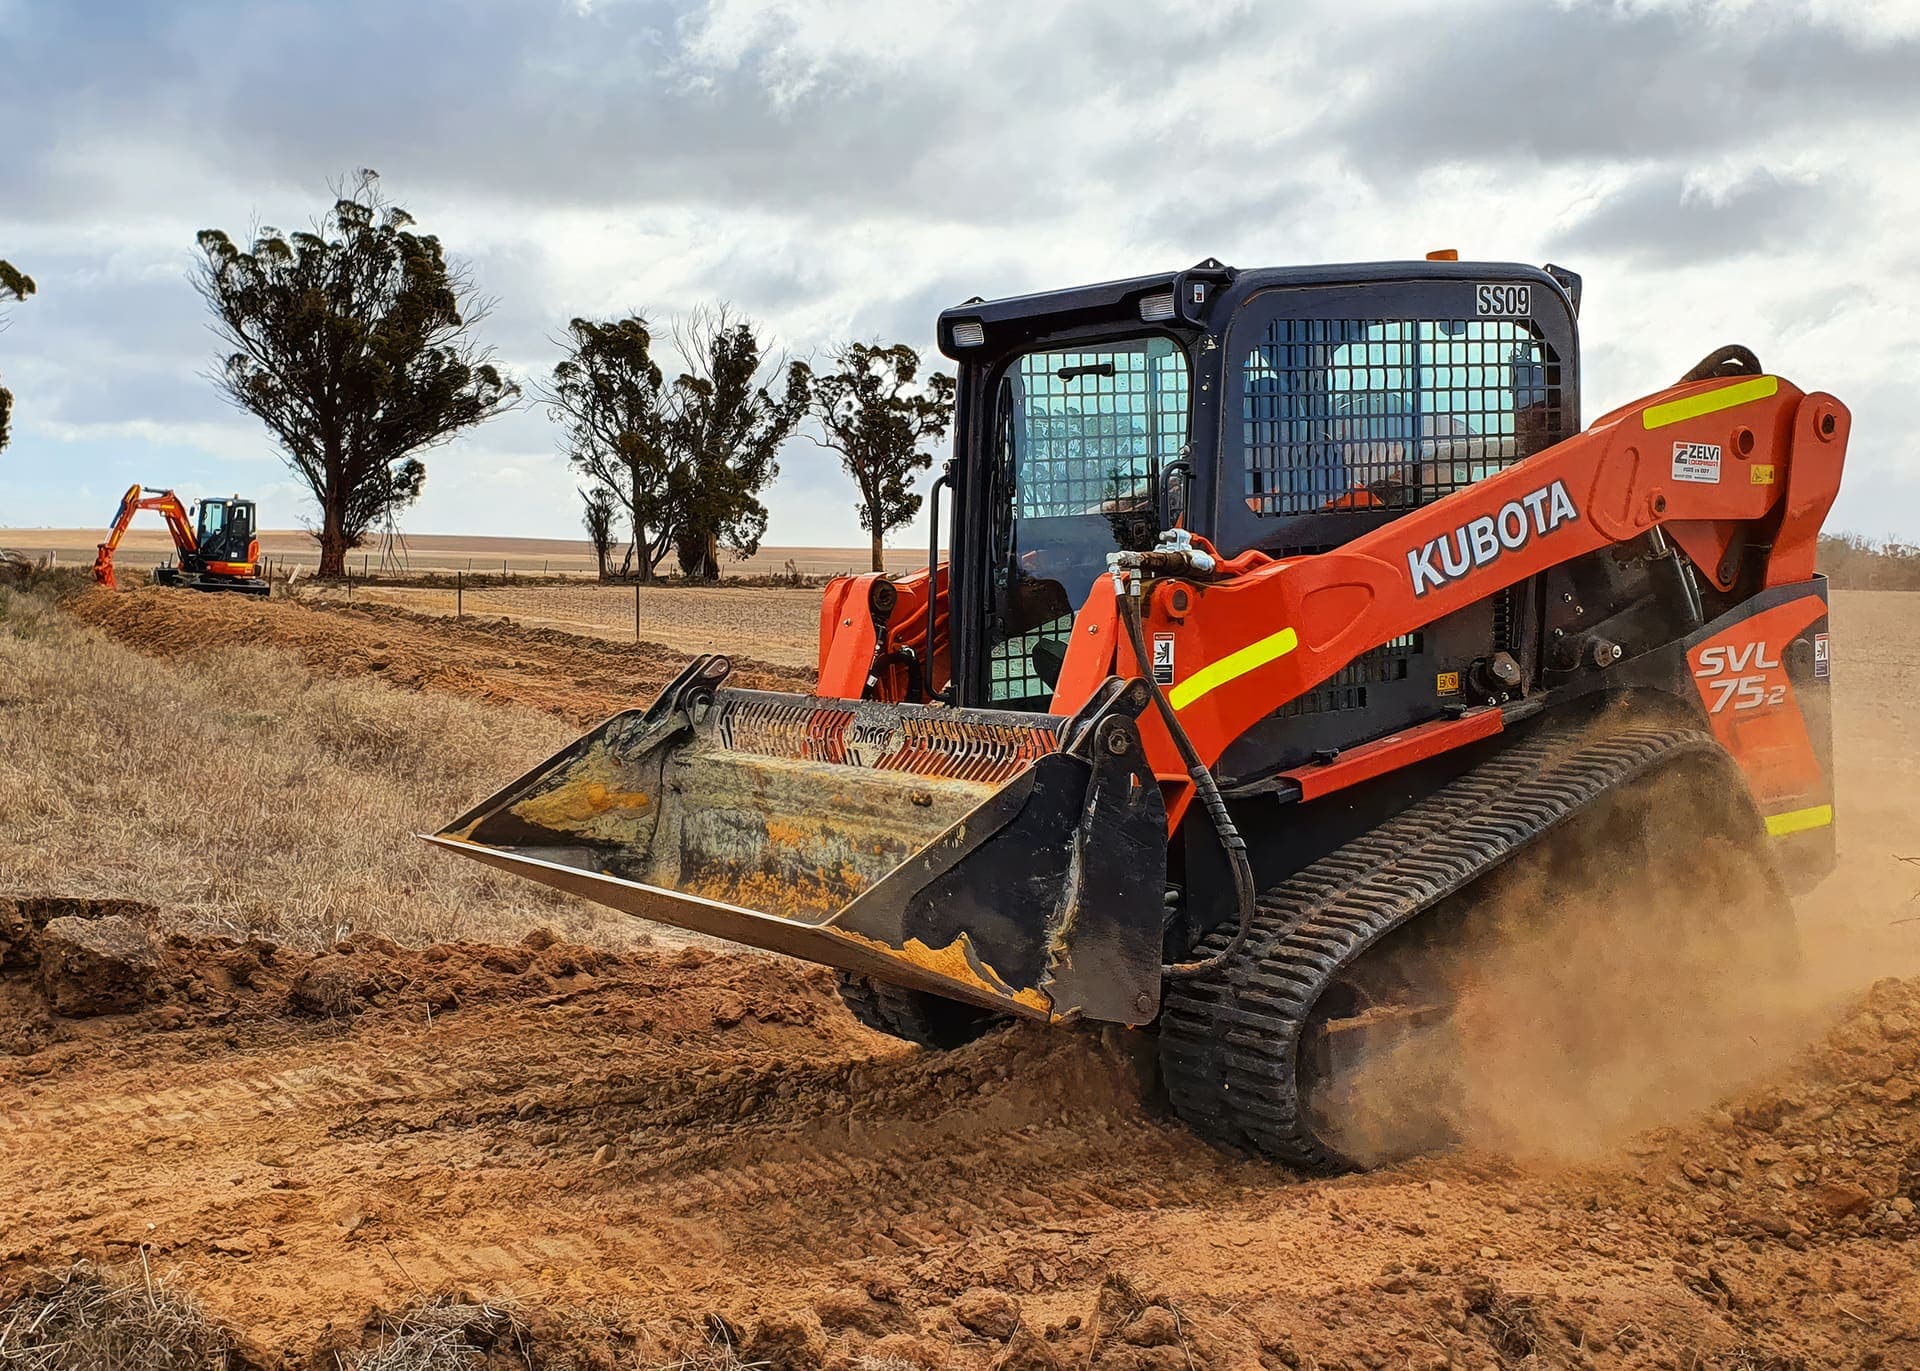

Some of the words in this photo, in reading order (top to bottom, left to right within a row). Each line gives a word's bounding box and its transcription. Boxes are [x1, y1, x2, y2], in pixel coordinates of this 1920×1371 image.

[1479, 286, 1529, 314] SS09
[1406, 479, 1578, 597] KUBOTA
[1695, 641, 1779, 677] SVL
